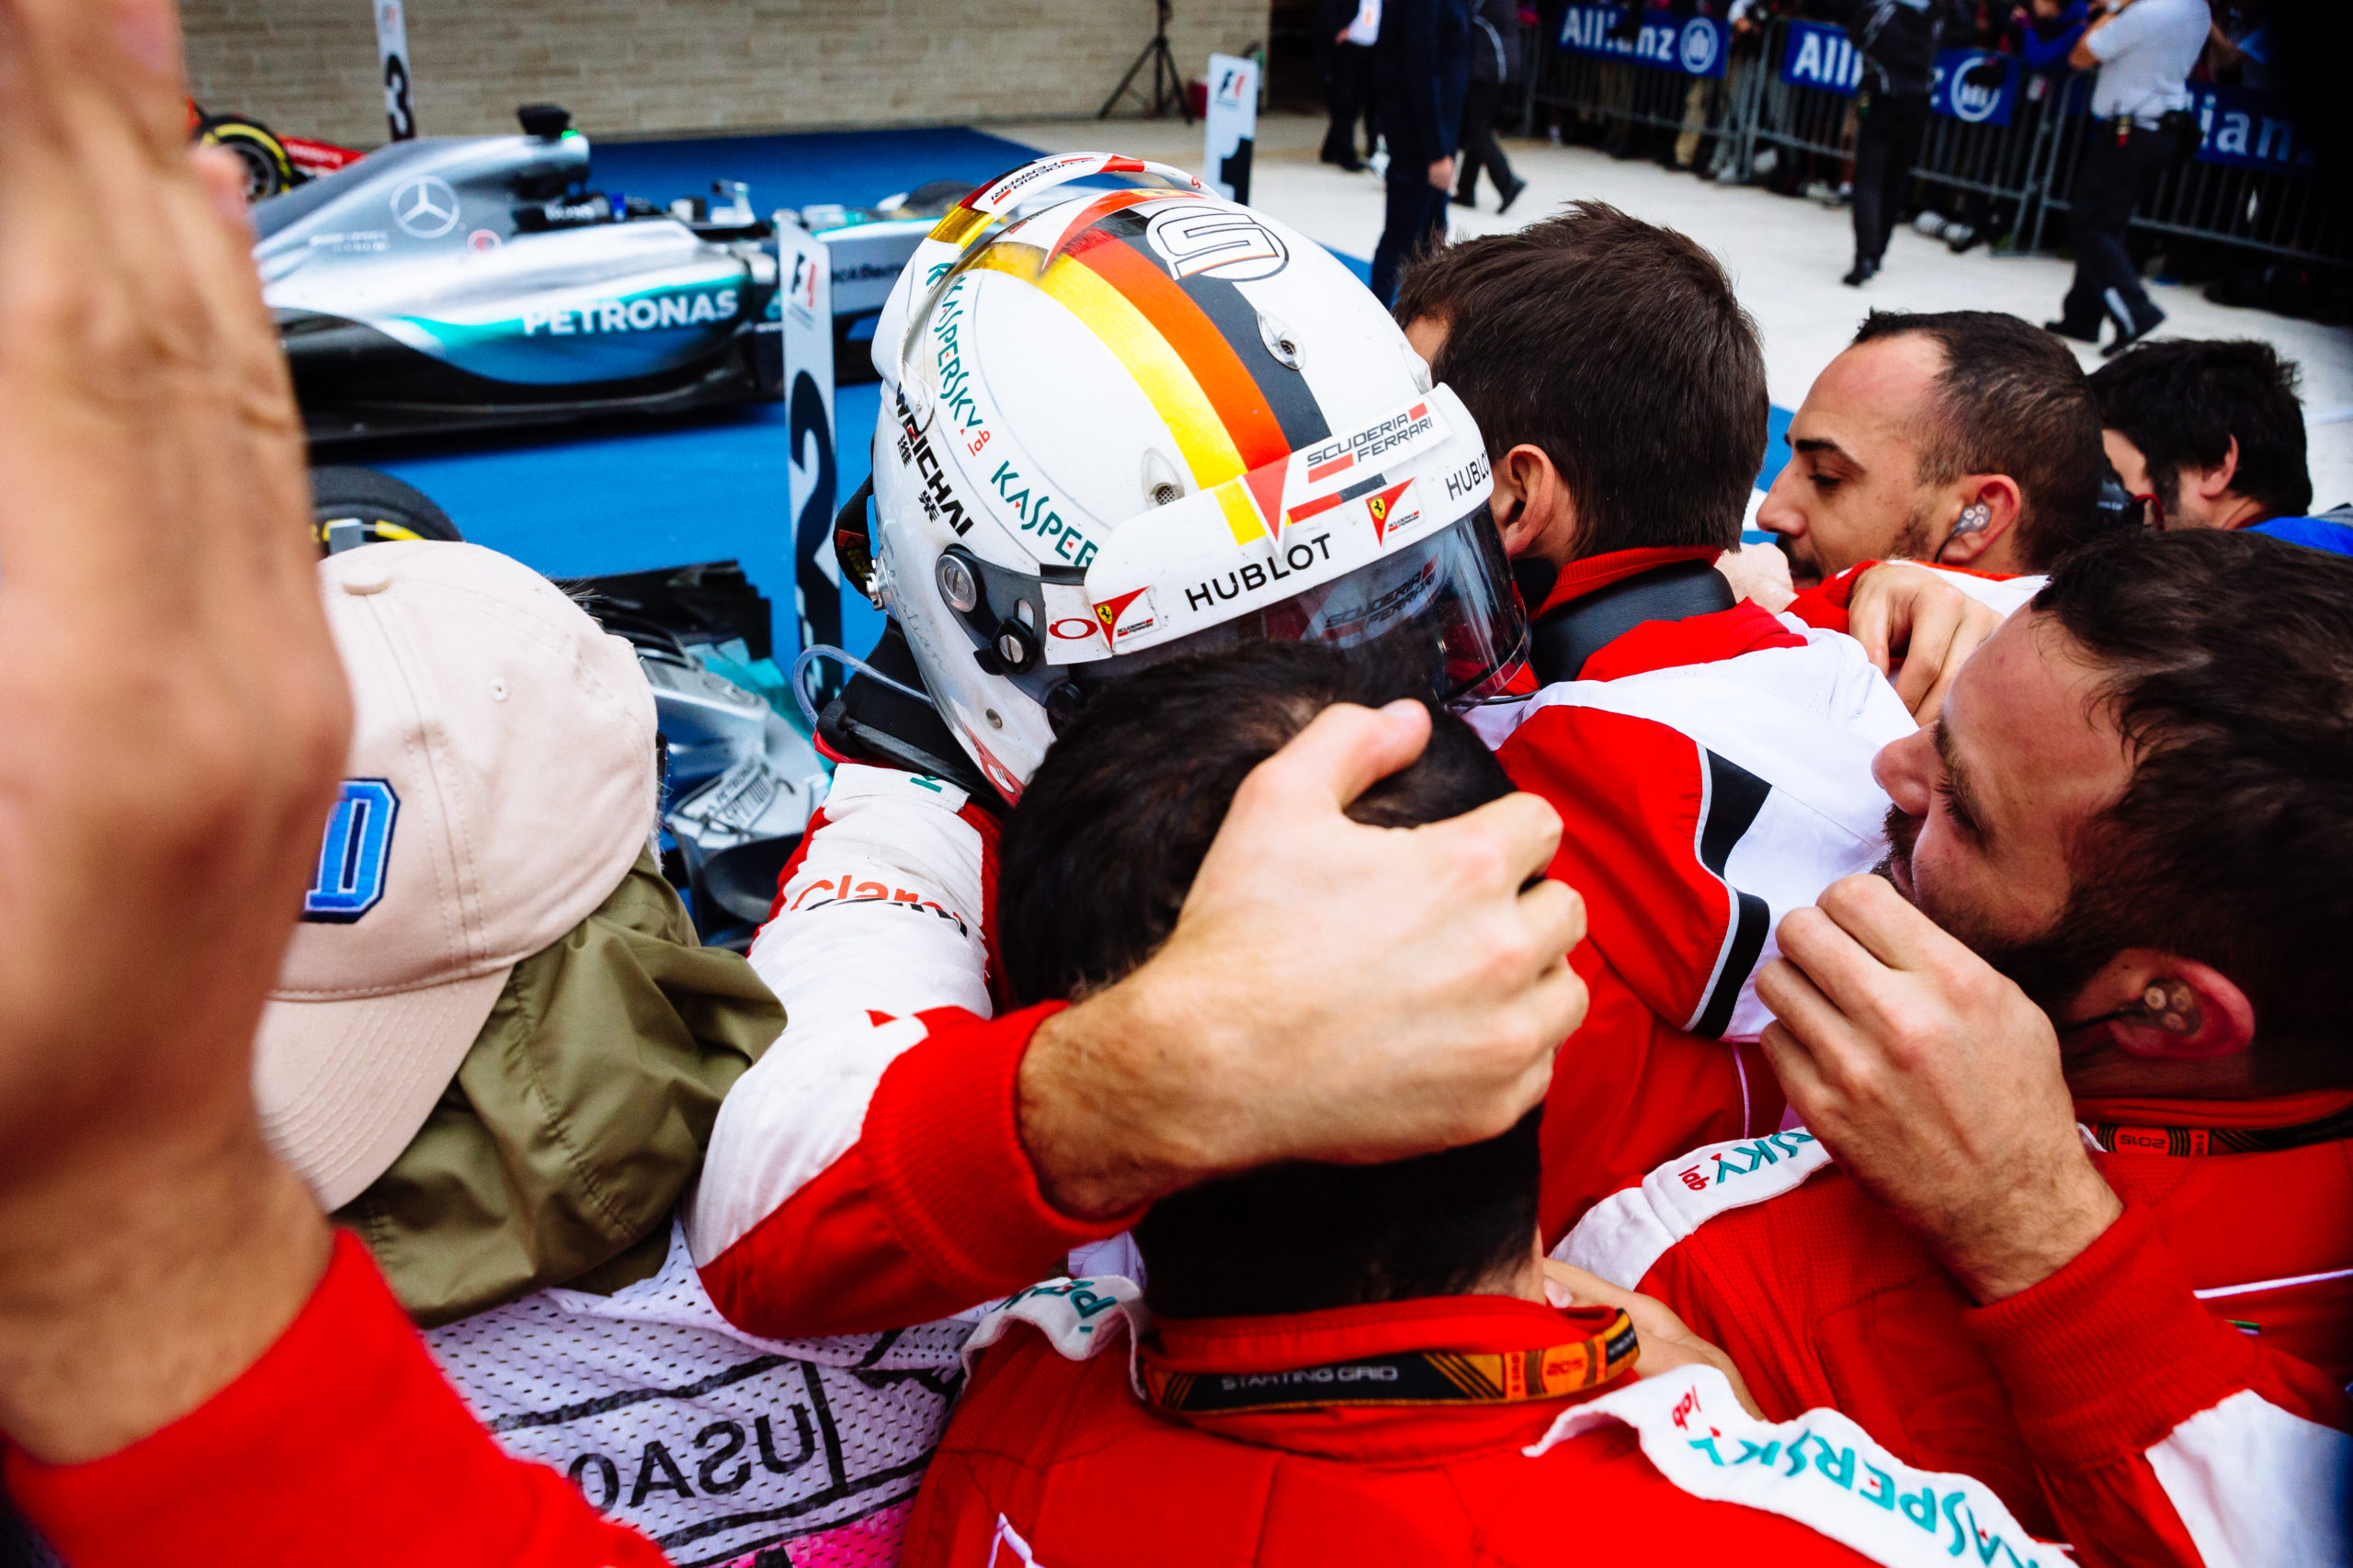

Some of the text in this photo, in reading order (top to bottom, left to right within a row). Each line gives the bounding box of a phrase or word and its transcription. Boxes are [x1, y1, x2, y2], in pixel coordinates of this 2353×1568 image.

[385, 52, 417, 141] 3
[1221, 137, 1252, 205] 1
[522, 289, 739, 337] PETRONAS
[967, 429, 992, 458] lab
[1307, 413, 1409, 468] SCUDERIA
[1358, 416, 1434, 463] FERRARI
[1445, 450, 1490, 501] HUBLO
[790, 369, 841, 636] 2
[1185, 532, 1331, 611] HUBLOT
[300, 777, 401, 925] D
[2119, 1133, 2165, 1149] 2015
[1678, 1164, 1710, 1191] lab
[1221, 1365, 1399, 1391] STARTING GRID
[1672, 1385, 1701, 1430] lab
